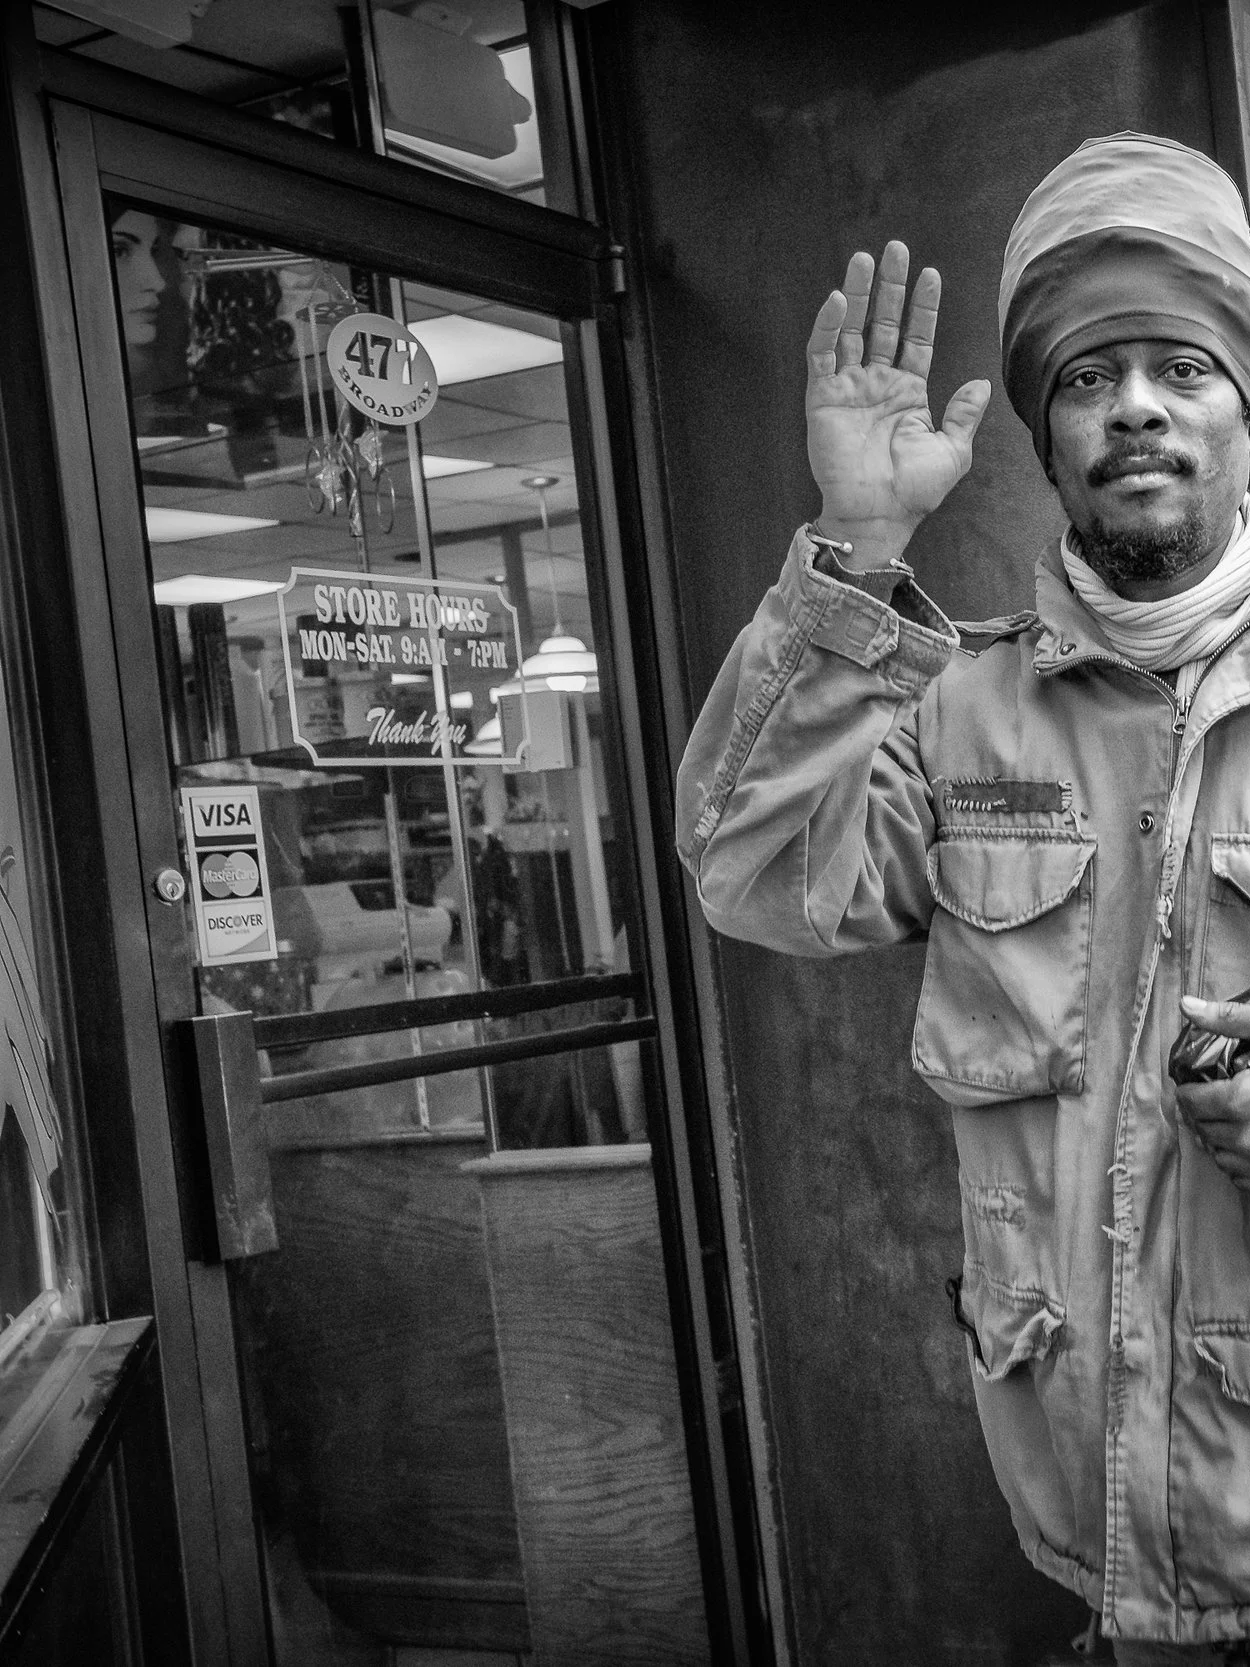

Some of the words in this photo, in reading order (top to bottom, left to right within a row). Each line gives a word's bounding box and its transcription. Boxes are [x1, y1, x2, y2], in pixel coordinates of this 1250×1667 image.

[345, 330, 419, 386] 477
[338, 365, 432, 418] BROADWAY
[314, 584, 401, 627] STORE
[406, 592, 489, 634] HOURS
[299, 629, 396, 664] MON-SAT.
[400, 635, 449, 666] 9:AM
[467, 639, 508, 669] 7:PM
[366, 707, 428, 746] Thank
[430, 711, 467, 756] You
[197, 803, 252, 827] VISA
[202, 868, 257, 884] MasterCard
[208, 913, 263, 930] DISCOVER
